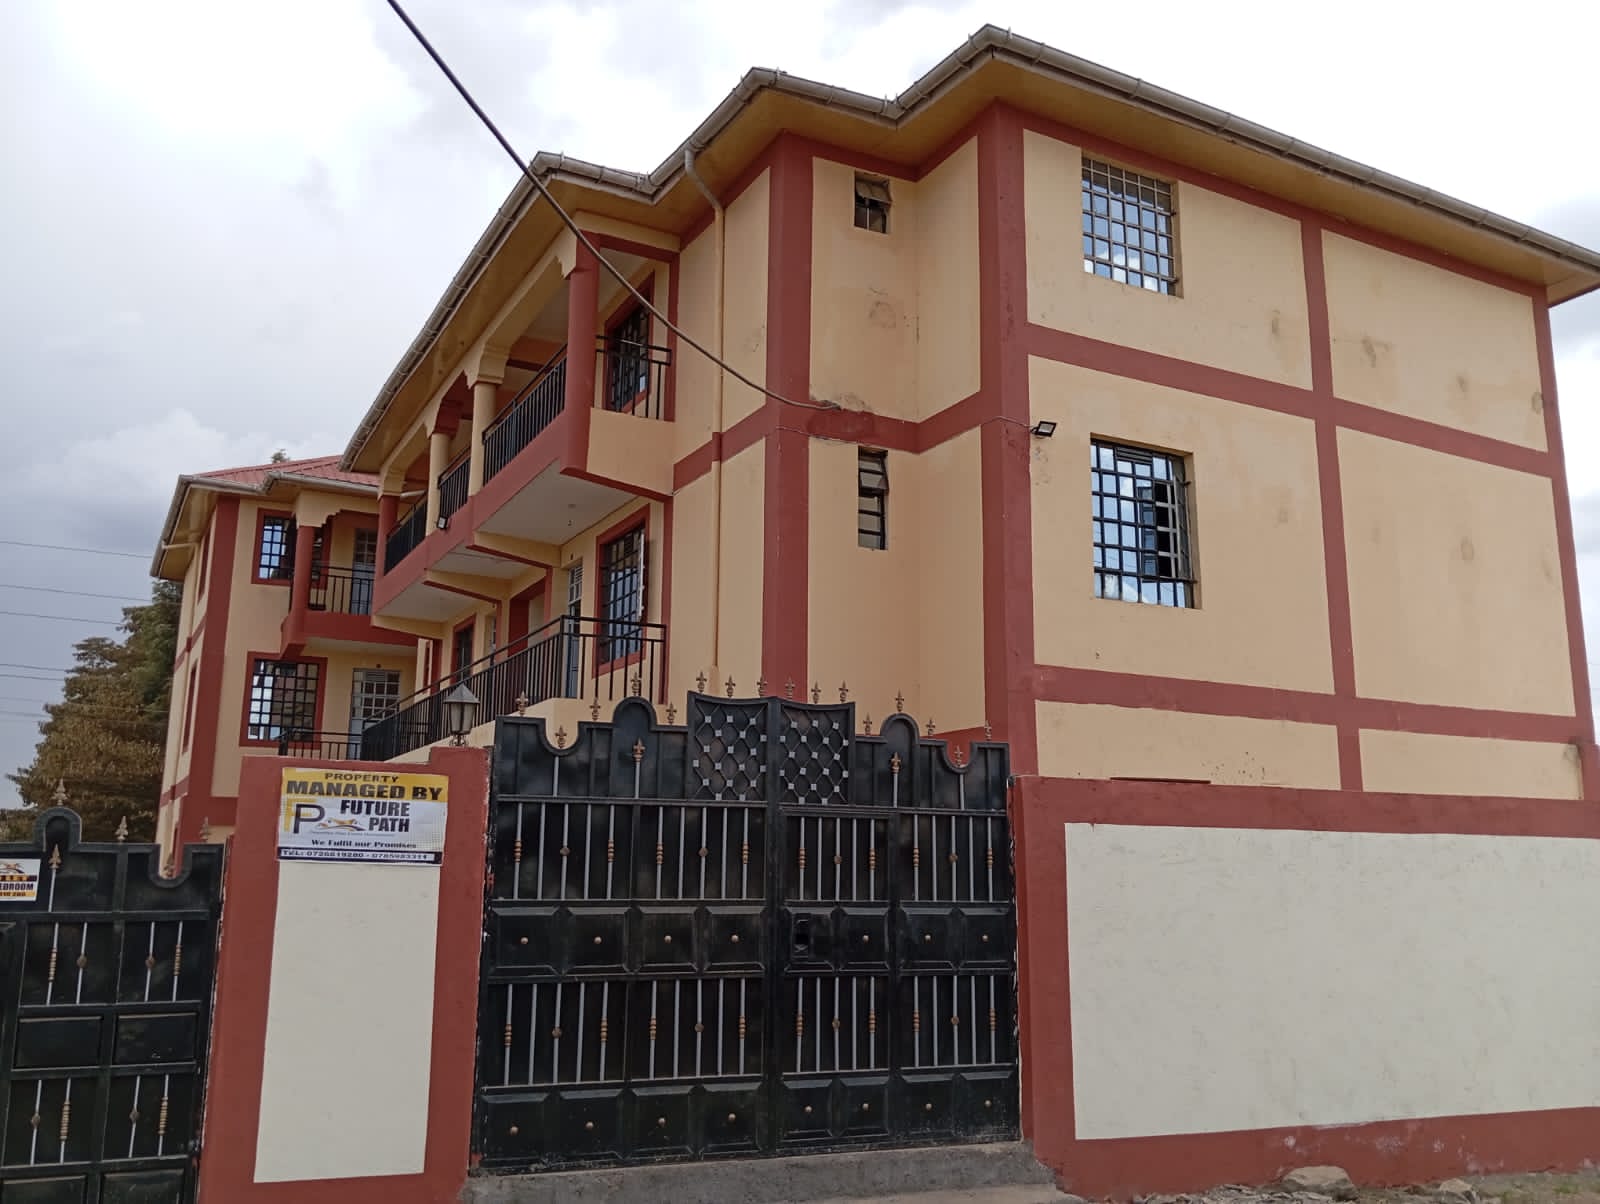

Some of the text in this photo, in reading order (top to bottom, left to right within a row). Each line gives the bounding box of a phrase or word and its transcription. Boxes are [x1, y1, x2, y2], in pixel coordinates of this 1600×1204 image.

[324, 772, 399, 783] PROPERTY
[286, 780, 443, 801] MANAGED BY
[340, 799, 411, 817] FUTURE
[368, 817, 410, 833] PATH
[373, 841, 417, 849] Promises
